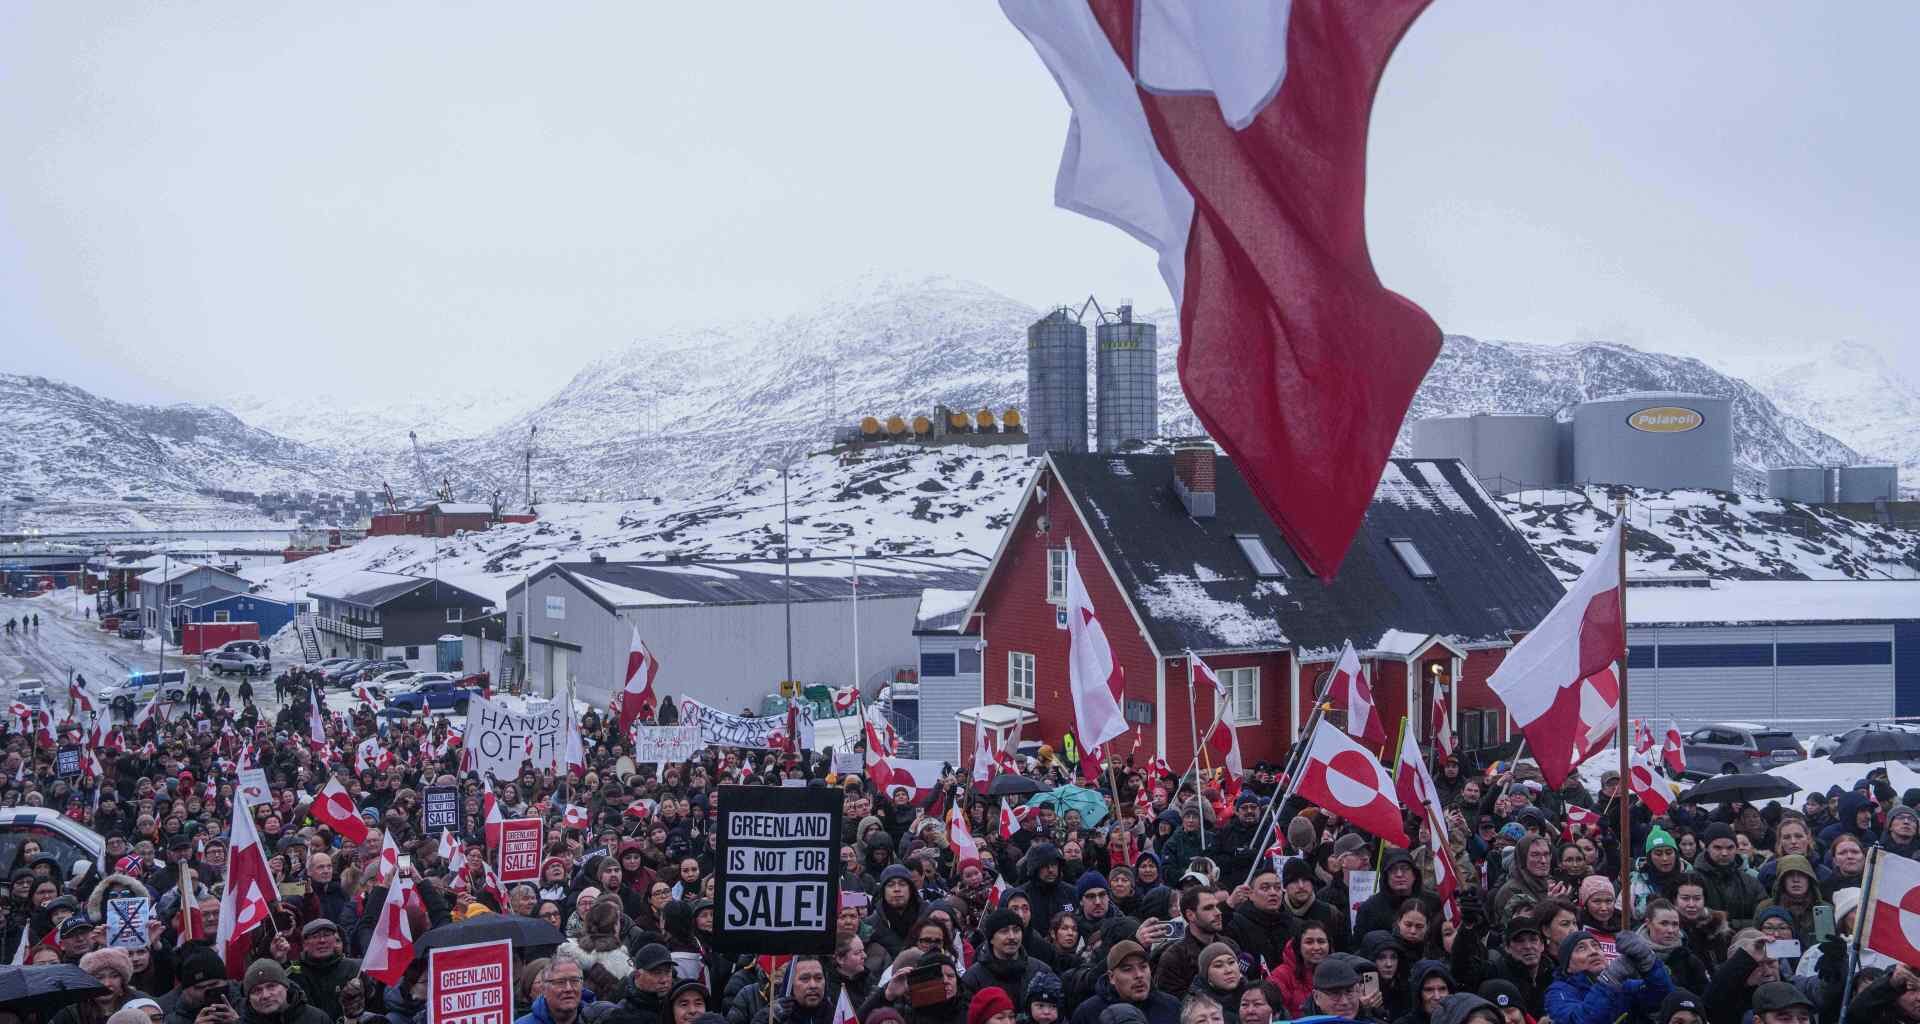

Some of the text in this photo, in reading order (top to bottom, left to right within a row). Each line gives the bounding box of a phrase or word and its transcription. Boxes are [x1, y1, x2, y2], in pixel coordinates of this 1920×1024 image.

[1638, 414, 1697, 425] Polaroil
[481, 708, 560, 731] HANDS
[429, 812, 455, 825] SALE!
[731, 815, 828, 838] GREENLAND
[505, 854, 536, 871] SALE!
[730, 850, 826, 871] IS NOT FOR
[728, 885, 825, 928] SALE!
[442, 966, 501, 988] GREENLAND
[443, 989, 501, 1012] IS NOT FOR
